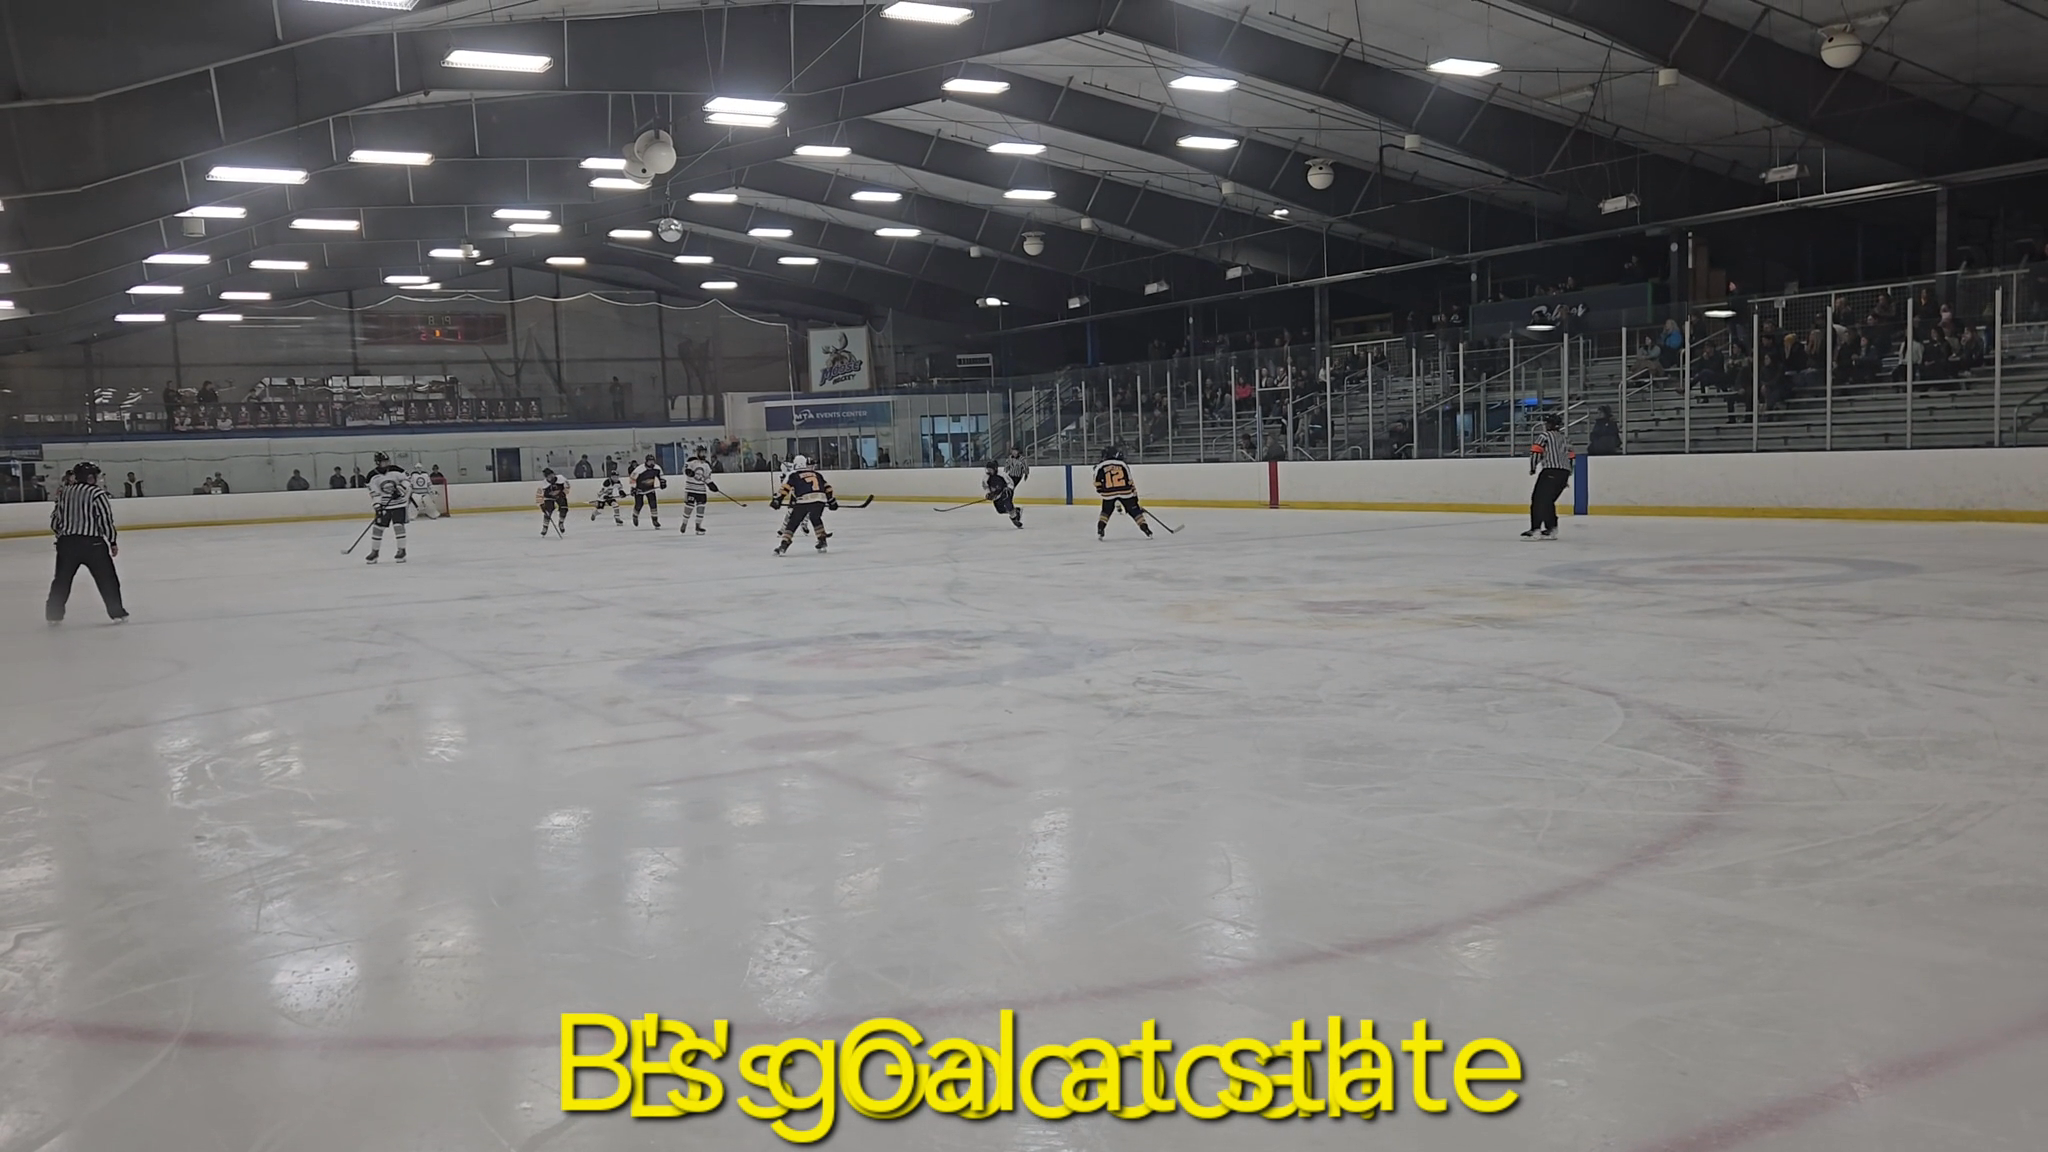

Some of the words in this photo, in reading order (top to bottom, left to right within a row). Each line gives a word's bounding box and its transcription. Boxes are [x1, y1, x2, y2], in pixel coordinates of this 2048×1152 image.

[832, 373, 857, 385] HOCKEY
[816, 411, 841, 419] EVENTS
[841, 410, 868, 418] CENTER
[804, 476, 820, 491] 7
[1105, 470, 1126, 488] 12
